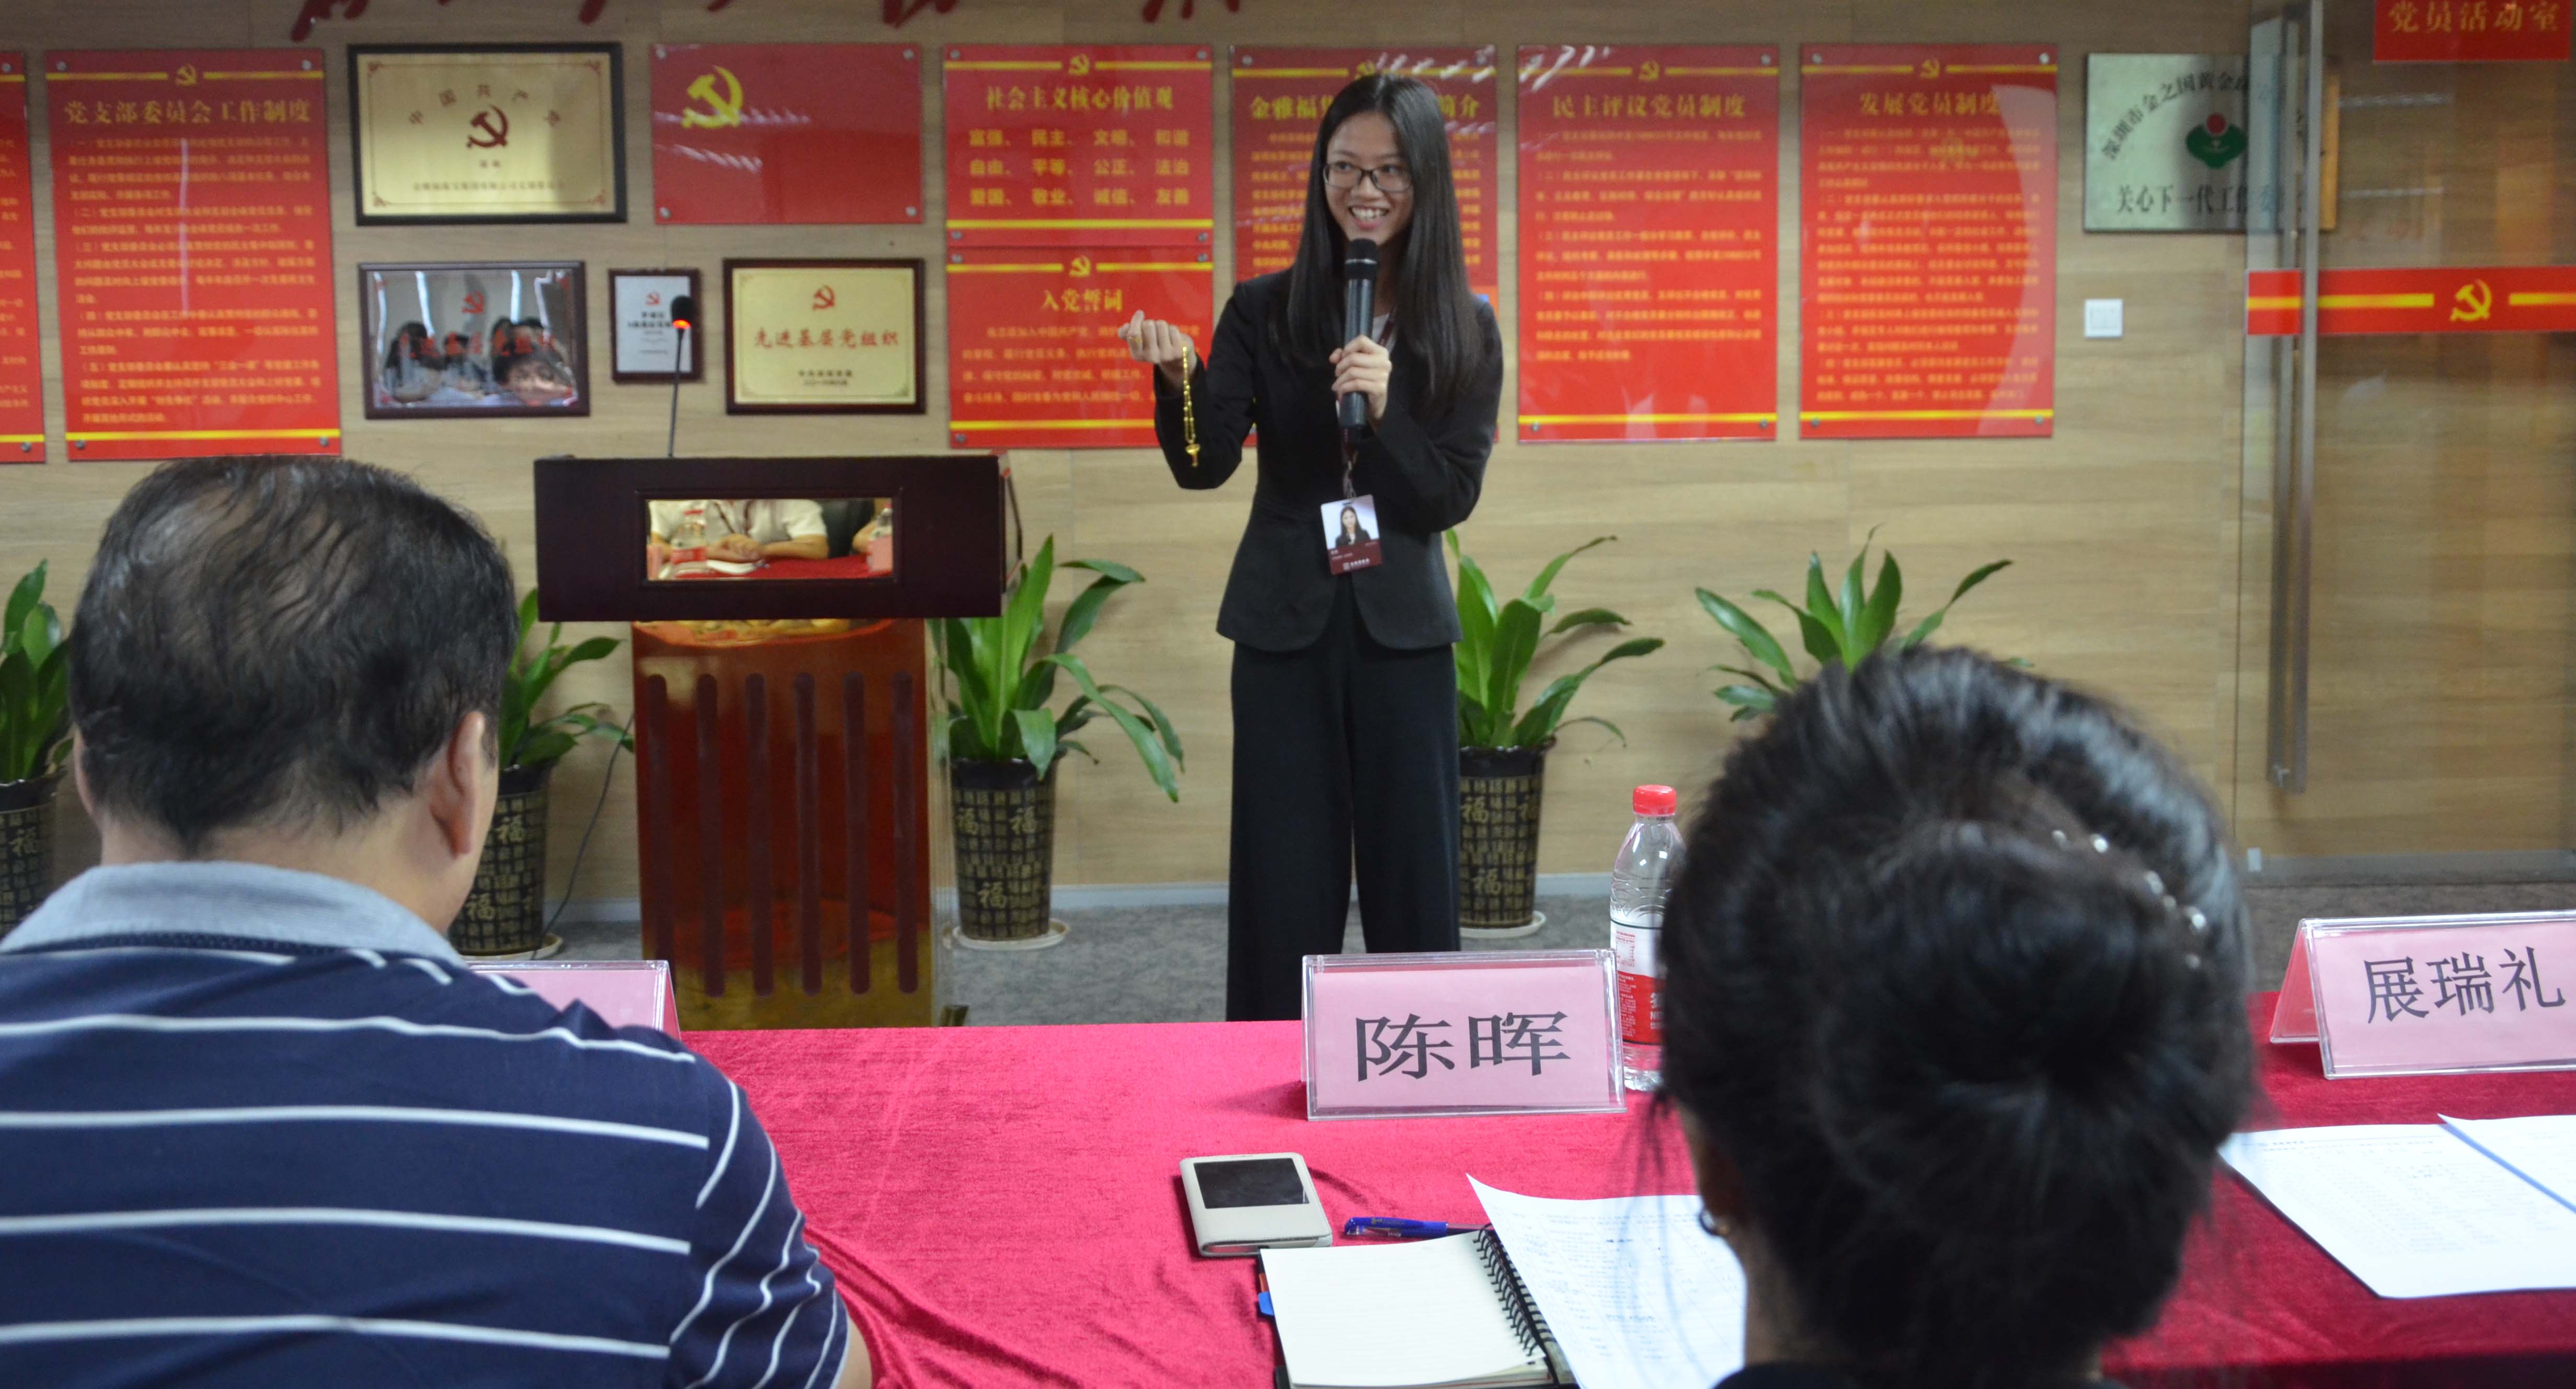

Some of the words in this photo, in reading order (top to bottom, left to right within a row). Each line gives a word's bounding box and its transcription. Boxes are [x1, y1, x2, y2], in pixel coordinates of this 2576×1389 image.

[987, 85, 1174, 111] 社会主义核心价值观
[1552, 94, 1746, 118] 民主评议党员制度
[64, 98, 311, 125] 党支部委员会工作制度
[1042, 288, 1123, 312] 入党誓词
[754, 328, 899, 349] 先进基层党组织
[2363, 946, 2567, 1024] 展瑞礼
[1355, 1011, 1572, 1083] 陈晖
